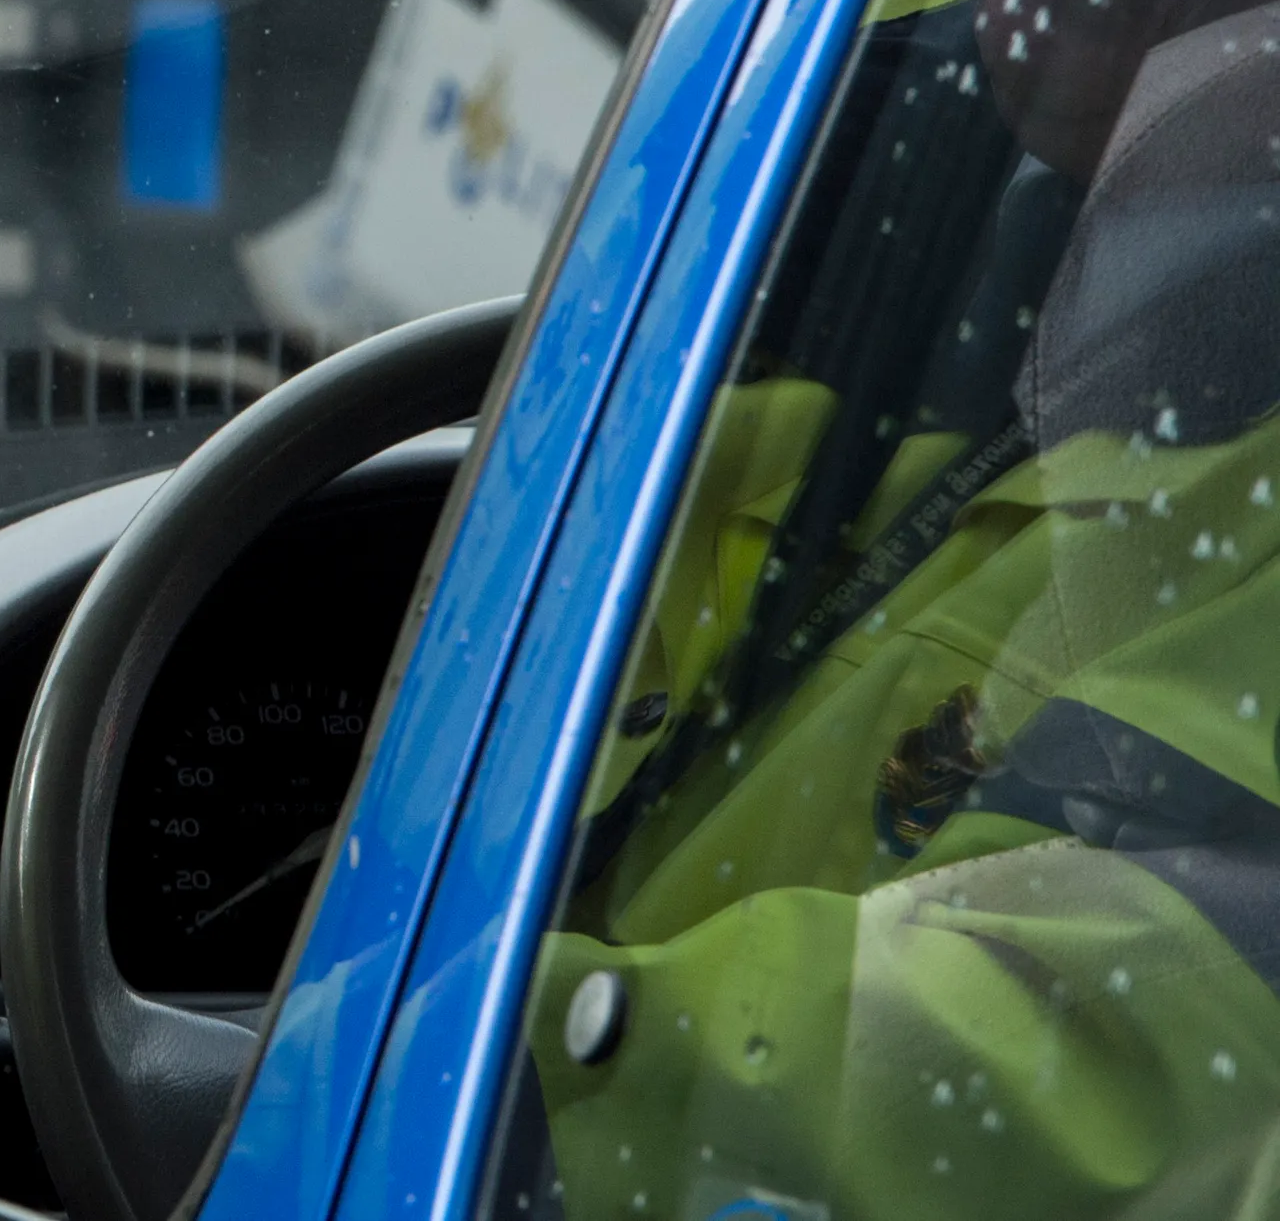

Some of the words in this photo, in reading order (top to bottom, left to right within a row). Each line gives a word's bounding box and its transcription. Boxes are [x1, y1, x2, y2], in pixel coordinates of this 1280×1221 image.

[258, 704, 302, 724] 100
[207, 725, 245, 745] 80
[322, 715, 364, 735] 120
[177, 767, 214, 786] 60
[164, 817, 200, 837] 40
[175, 870, 211, 890] 20
